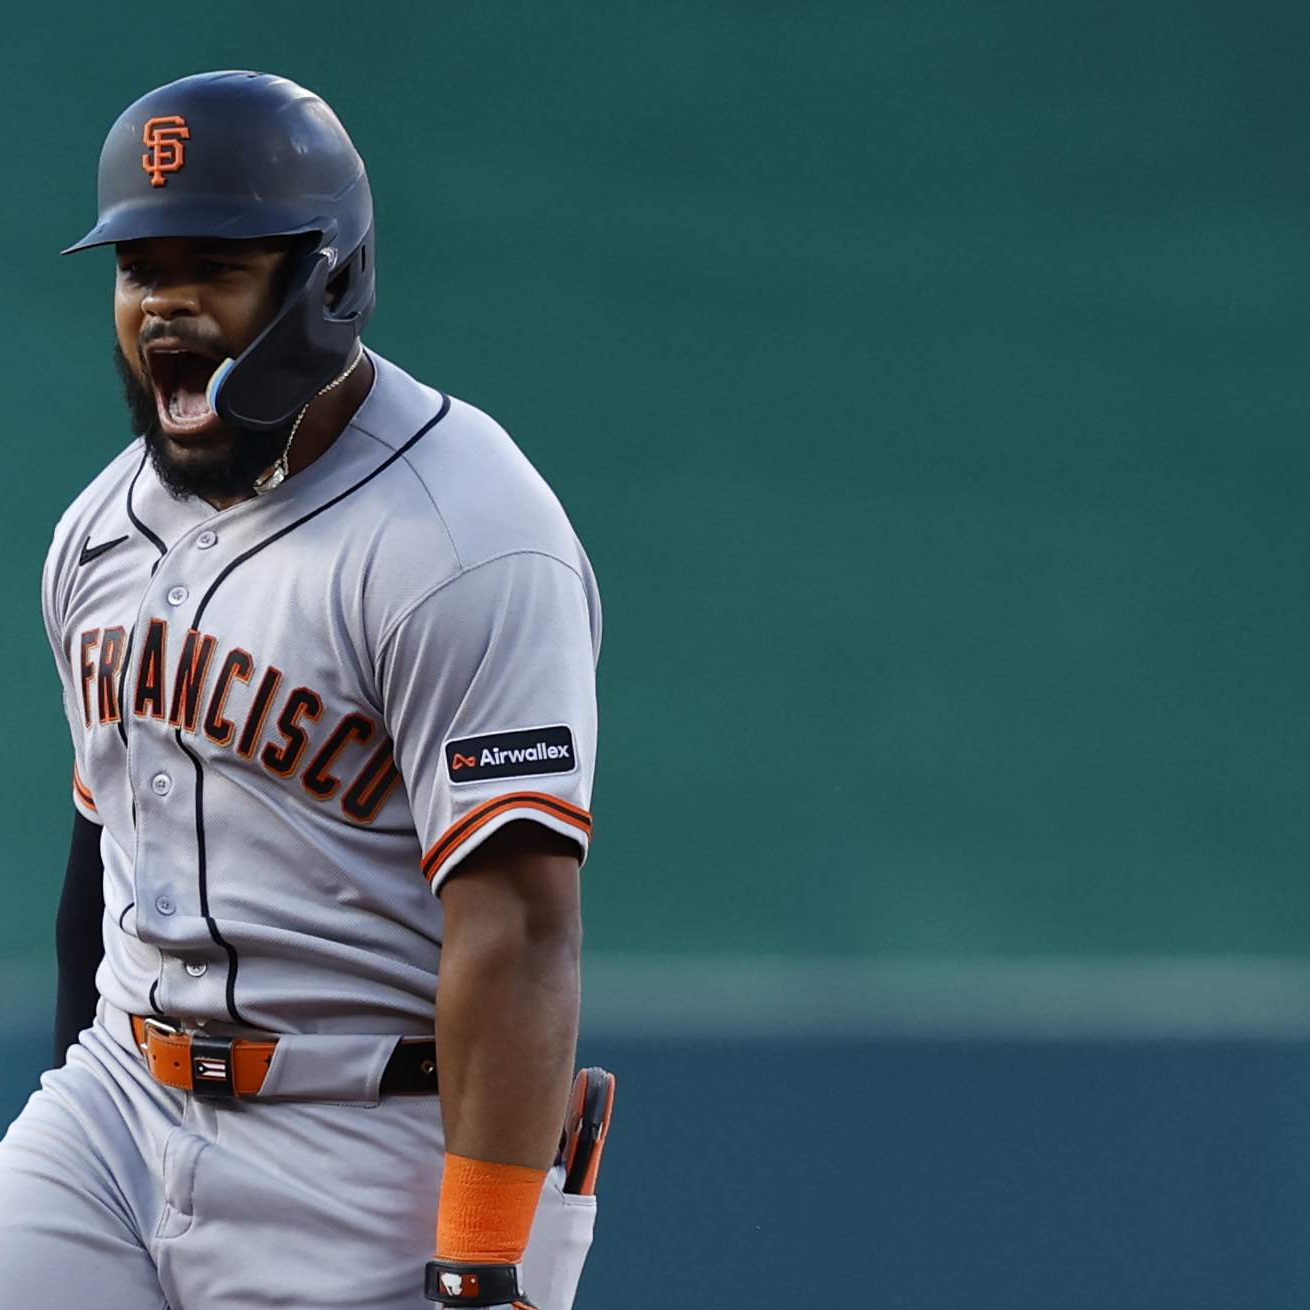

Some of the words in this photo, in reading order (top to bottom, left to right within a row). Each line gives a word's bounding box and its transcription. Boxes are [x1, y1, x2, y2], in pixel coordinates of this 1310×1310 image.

[142, 114, 190, 187] SF
[80, 617, 403, 826] FRANCISCO
[479, 742, 570, 767] Airwallex
